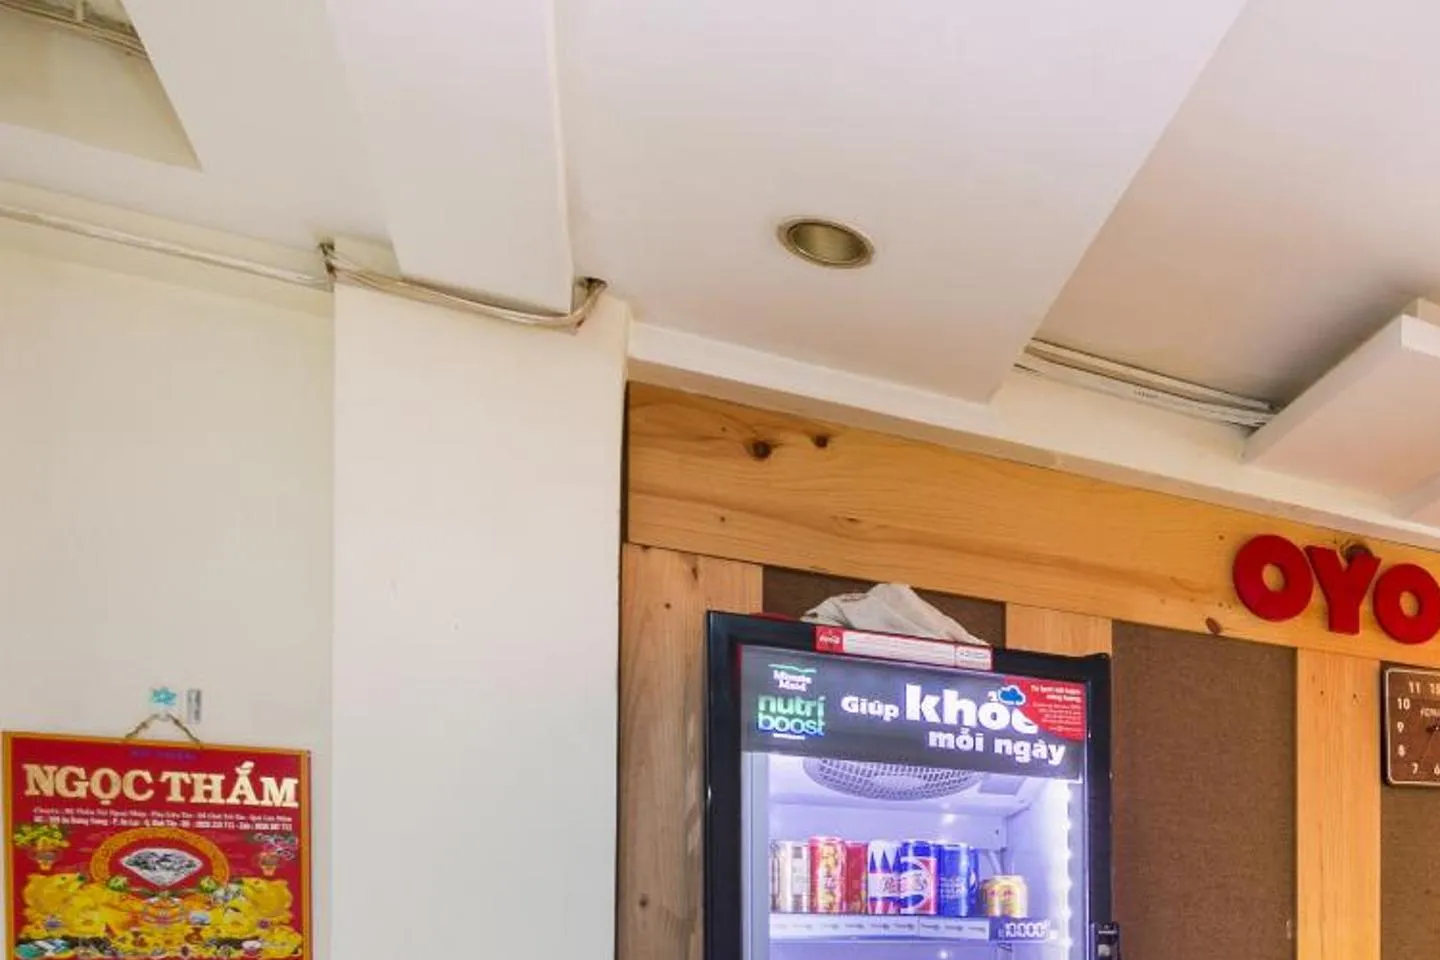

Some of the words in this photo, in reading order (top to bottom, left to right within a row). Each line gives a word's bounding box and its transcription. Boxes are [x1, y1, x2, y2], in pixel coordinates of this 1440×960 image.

[758, 695, 826, 718] nutri
[841, 695, 899, 721] Giúp
[1397, 698, 1411, 710] 10
[758, 712, 826, 736] boost
[928, 727, 984, 752] mỗi
[994, 736, 1066, 766] ngày
[22, 763, 155, 805] NGỌC
